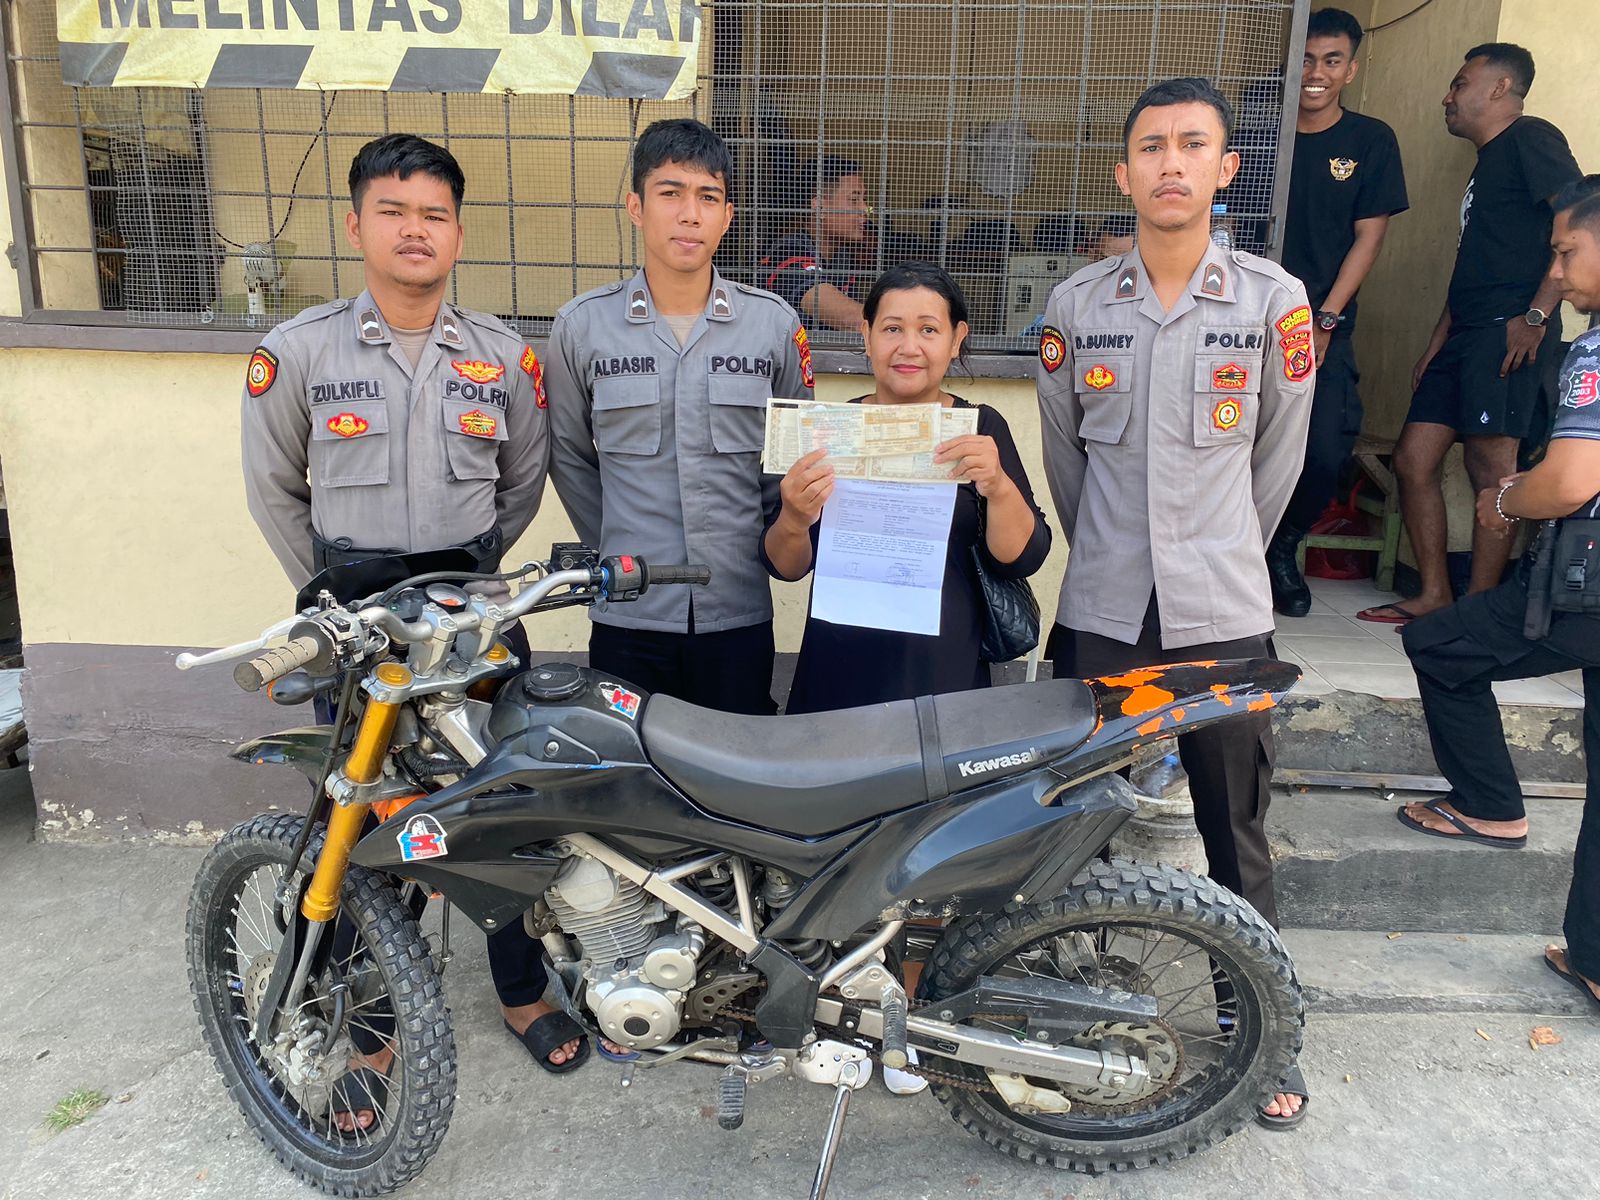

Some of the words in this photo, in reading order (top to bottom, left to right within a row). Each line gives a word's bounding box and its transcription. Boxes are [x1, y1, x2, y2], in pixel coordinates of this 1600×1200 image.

[1074, 333, 1134, 350] D.BUINEY
[1205, 332, 1263, 350] POLRI
[594, 356, 656, 378] ALBASIR
[711, 355, 771, 377] POLRI
[311, 380, 380, 403] ZULKIFLI
[446, 380, 508, 407] POLRI
[958, 746, 1042, 777] Kawasa
